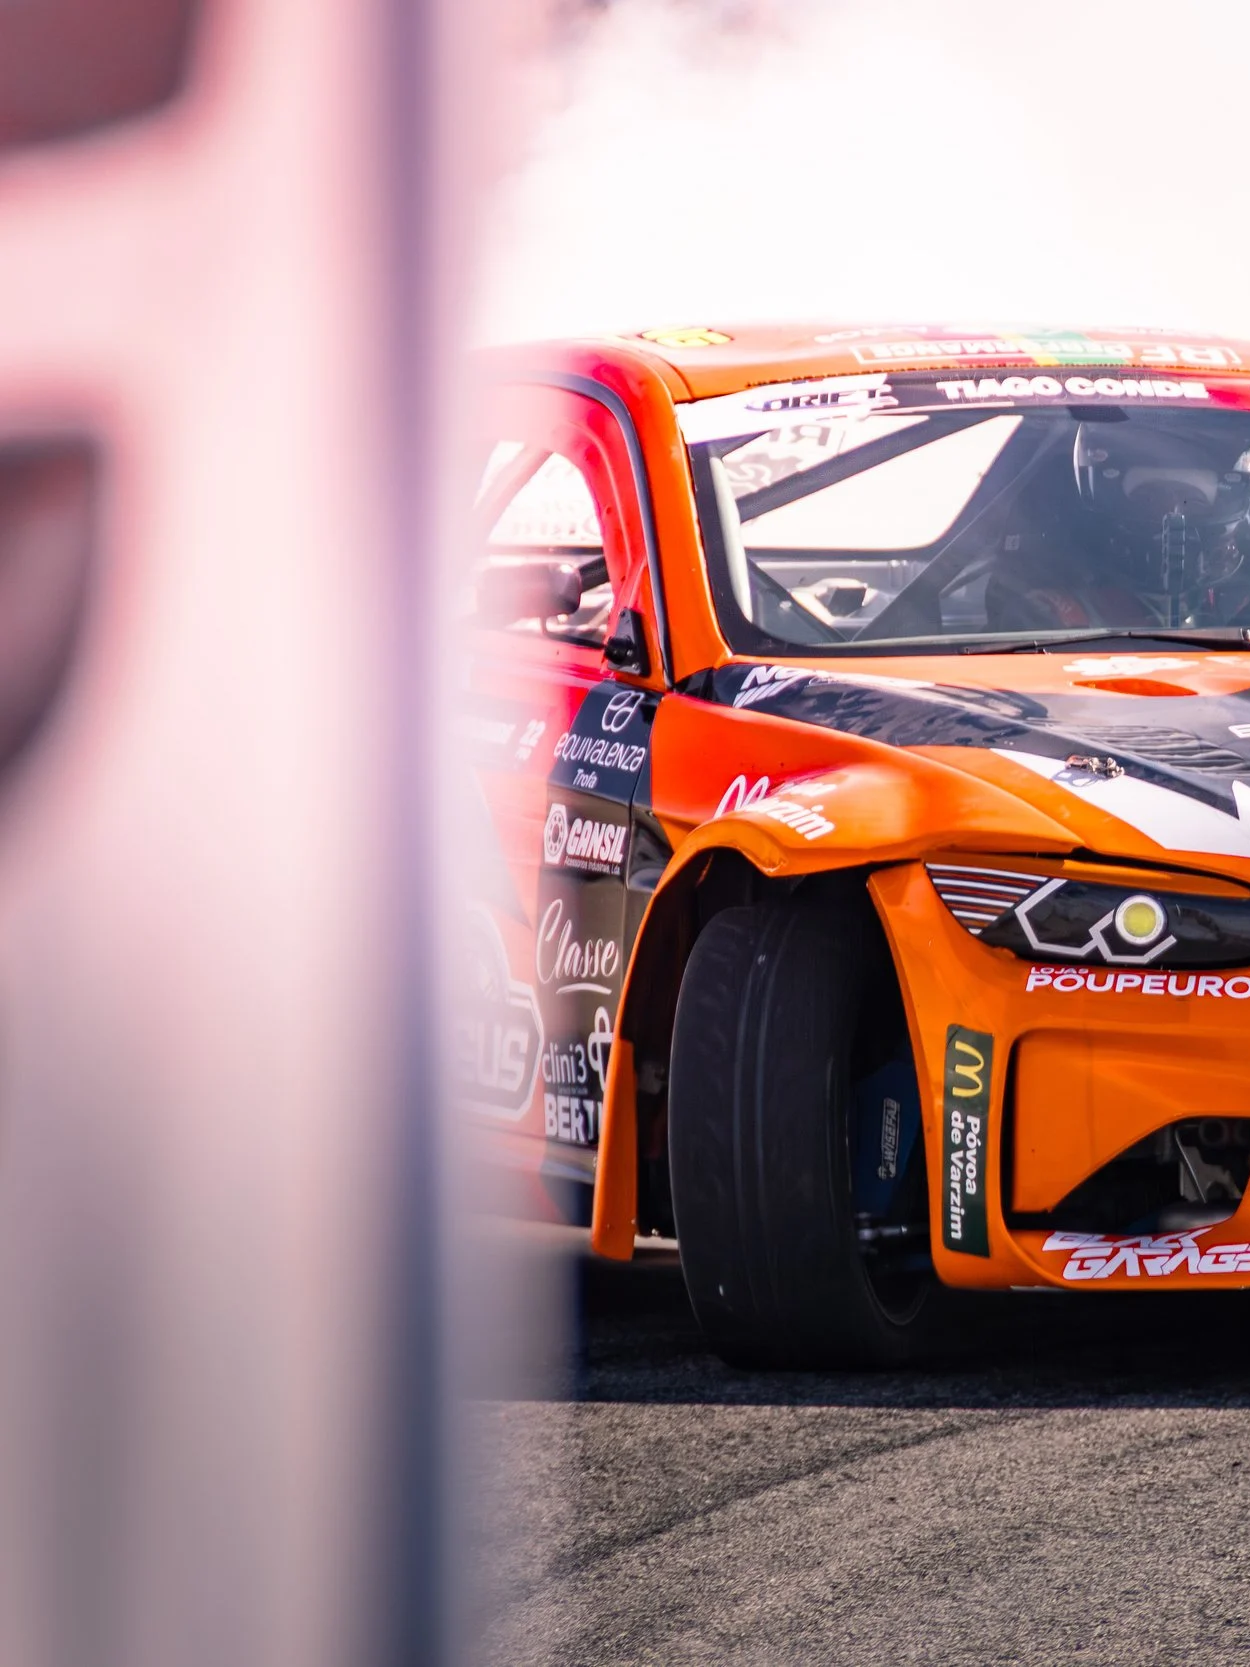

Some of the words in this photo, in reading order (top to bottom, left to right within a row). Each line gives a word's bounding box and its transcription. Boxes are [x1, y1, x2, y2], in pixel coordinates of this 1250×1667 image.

[936, 376, 1062, 399] TIAGO
[1064, 377, 1209, 399] CONDE
[572, 768, 598, 788] Trofa
[566, 818, 627, 863] GANSIL
[536, 898, 619, 984] Classe
[542, 1042, 587, 1084] clini3
[951, 1110, 965, 1145] de
[966, 1115, 981, 1195] Póvoa
[950, 1150, 965, 1240] Varzim
